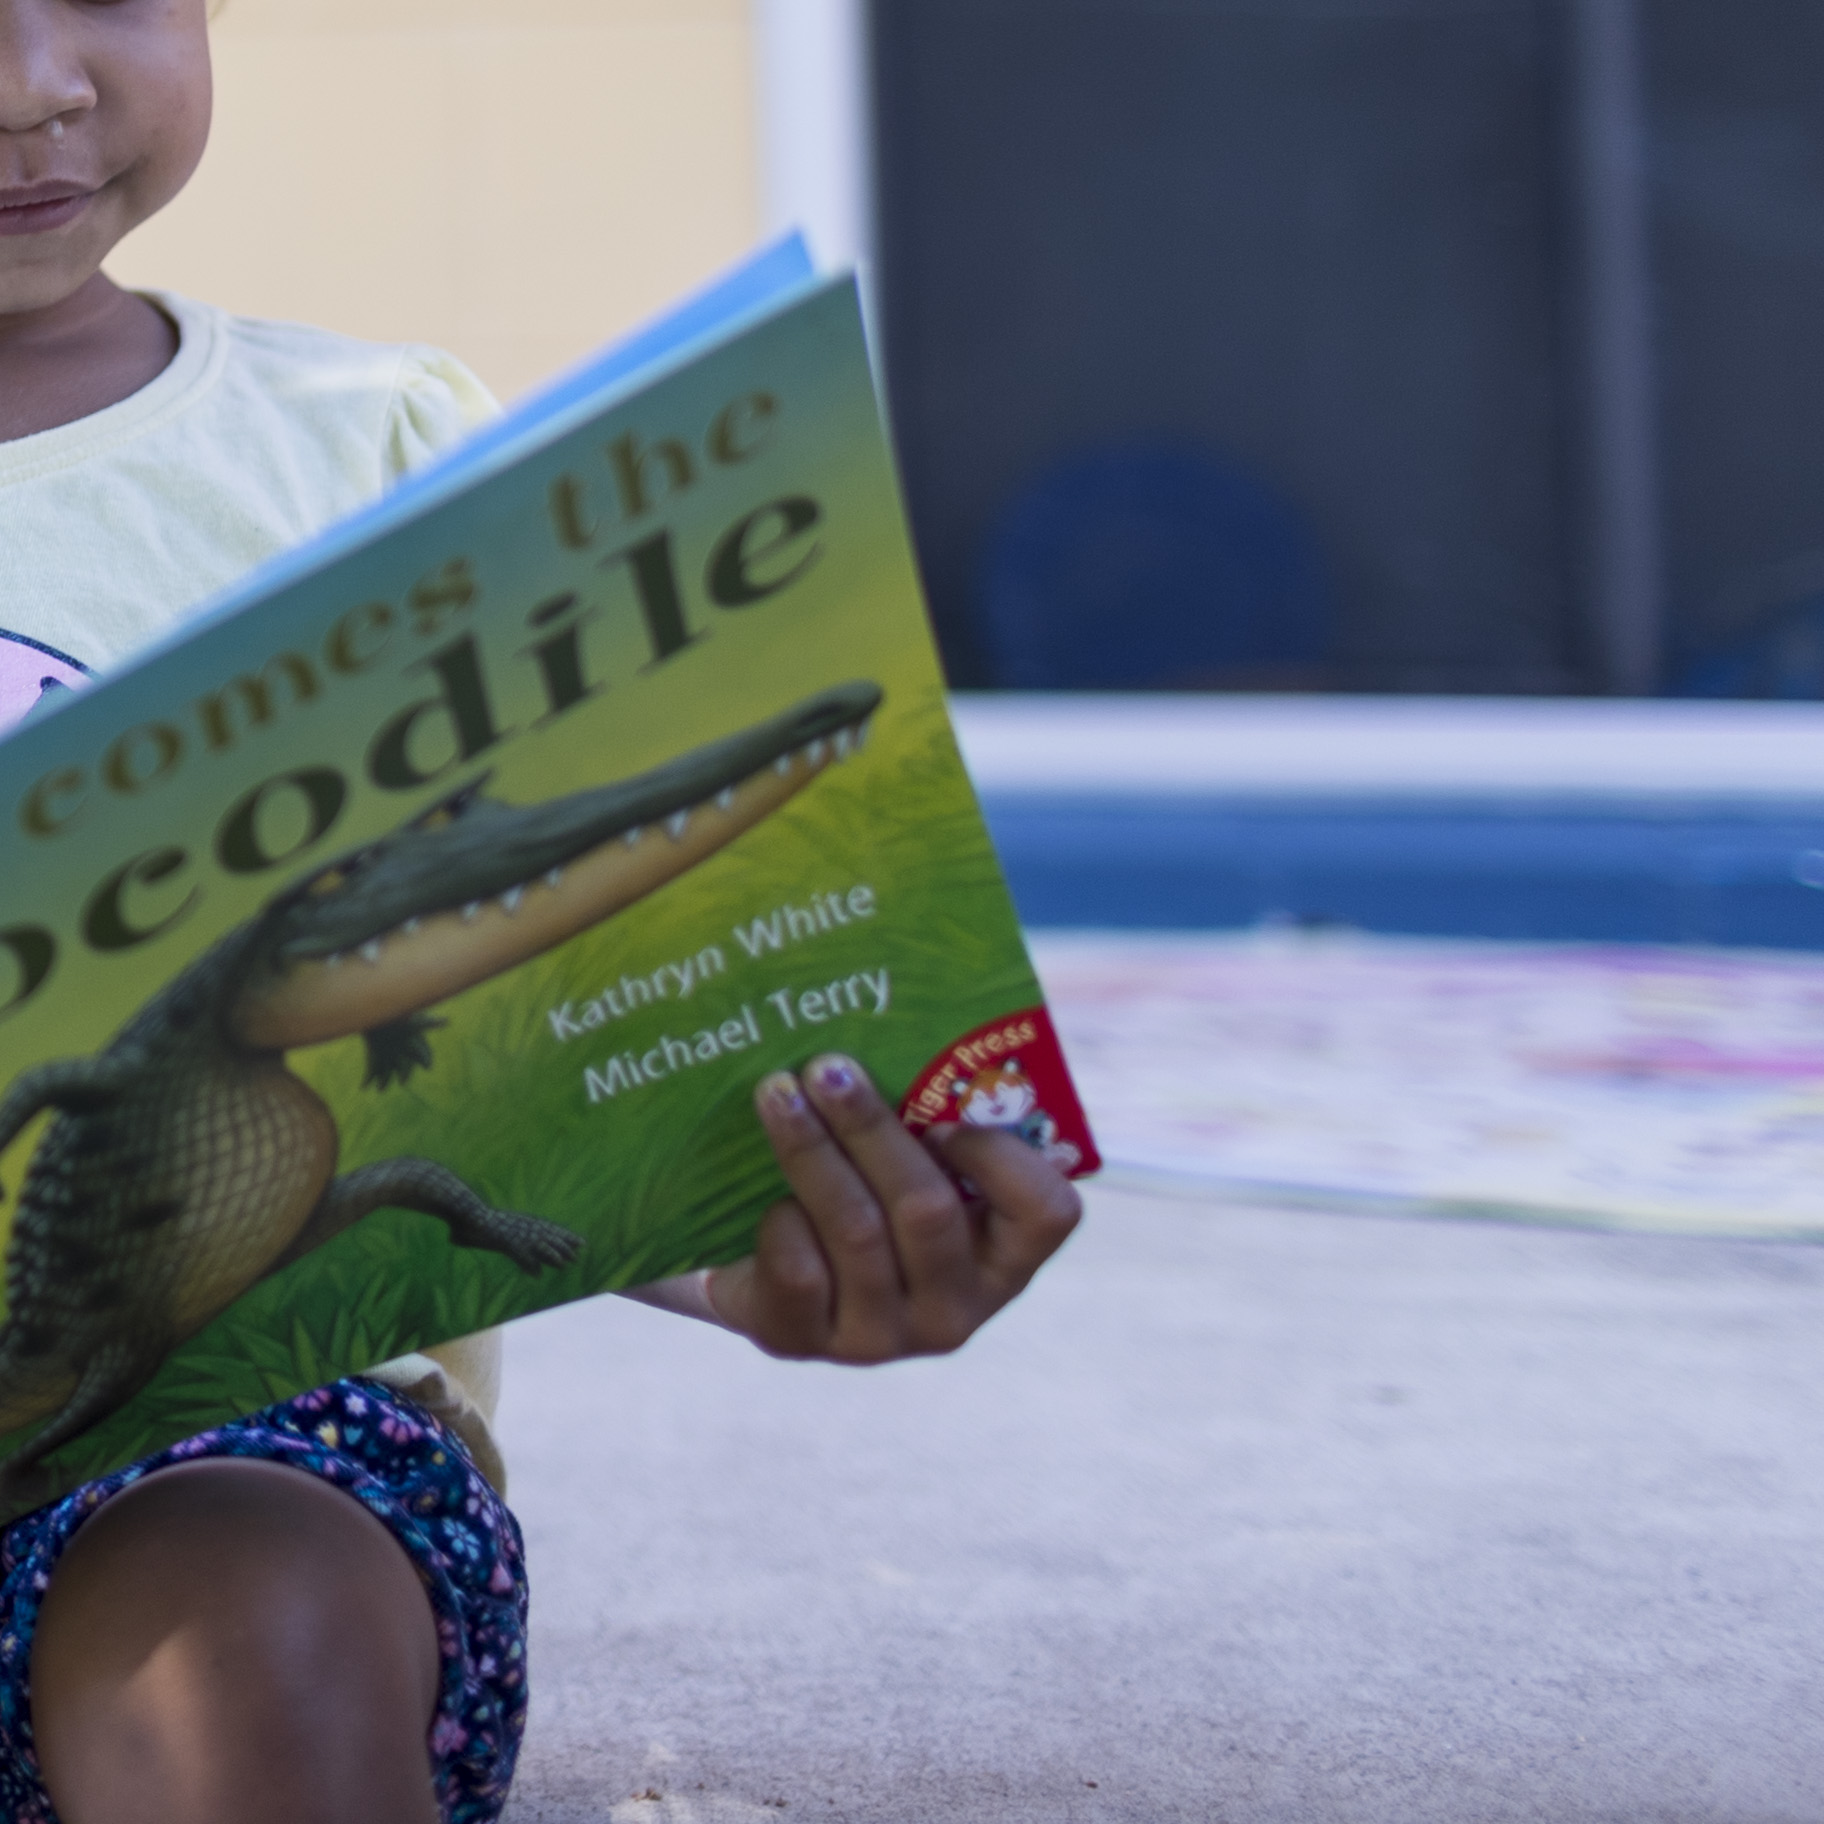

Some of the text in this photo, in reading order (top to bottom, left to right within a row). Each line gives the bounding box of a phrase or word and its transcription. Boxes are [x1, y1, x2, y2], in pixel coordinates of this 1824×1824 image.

[16, 555, 487, 844] comes
[550, 387, 783, 552] the
[547, 883, 877, 1042] Kathryn White
[582, 966, 891, 1104] Michael Terry
[904, 1019, 1038, 1125] Tiger Press
